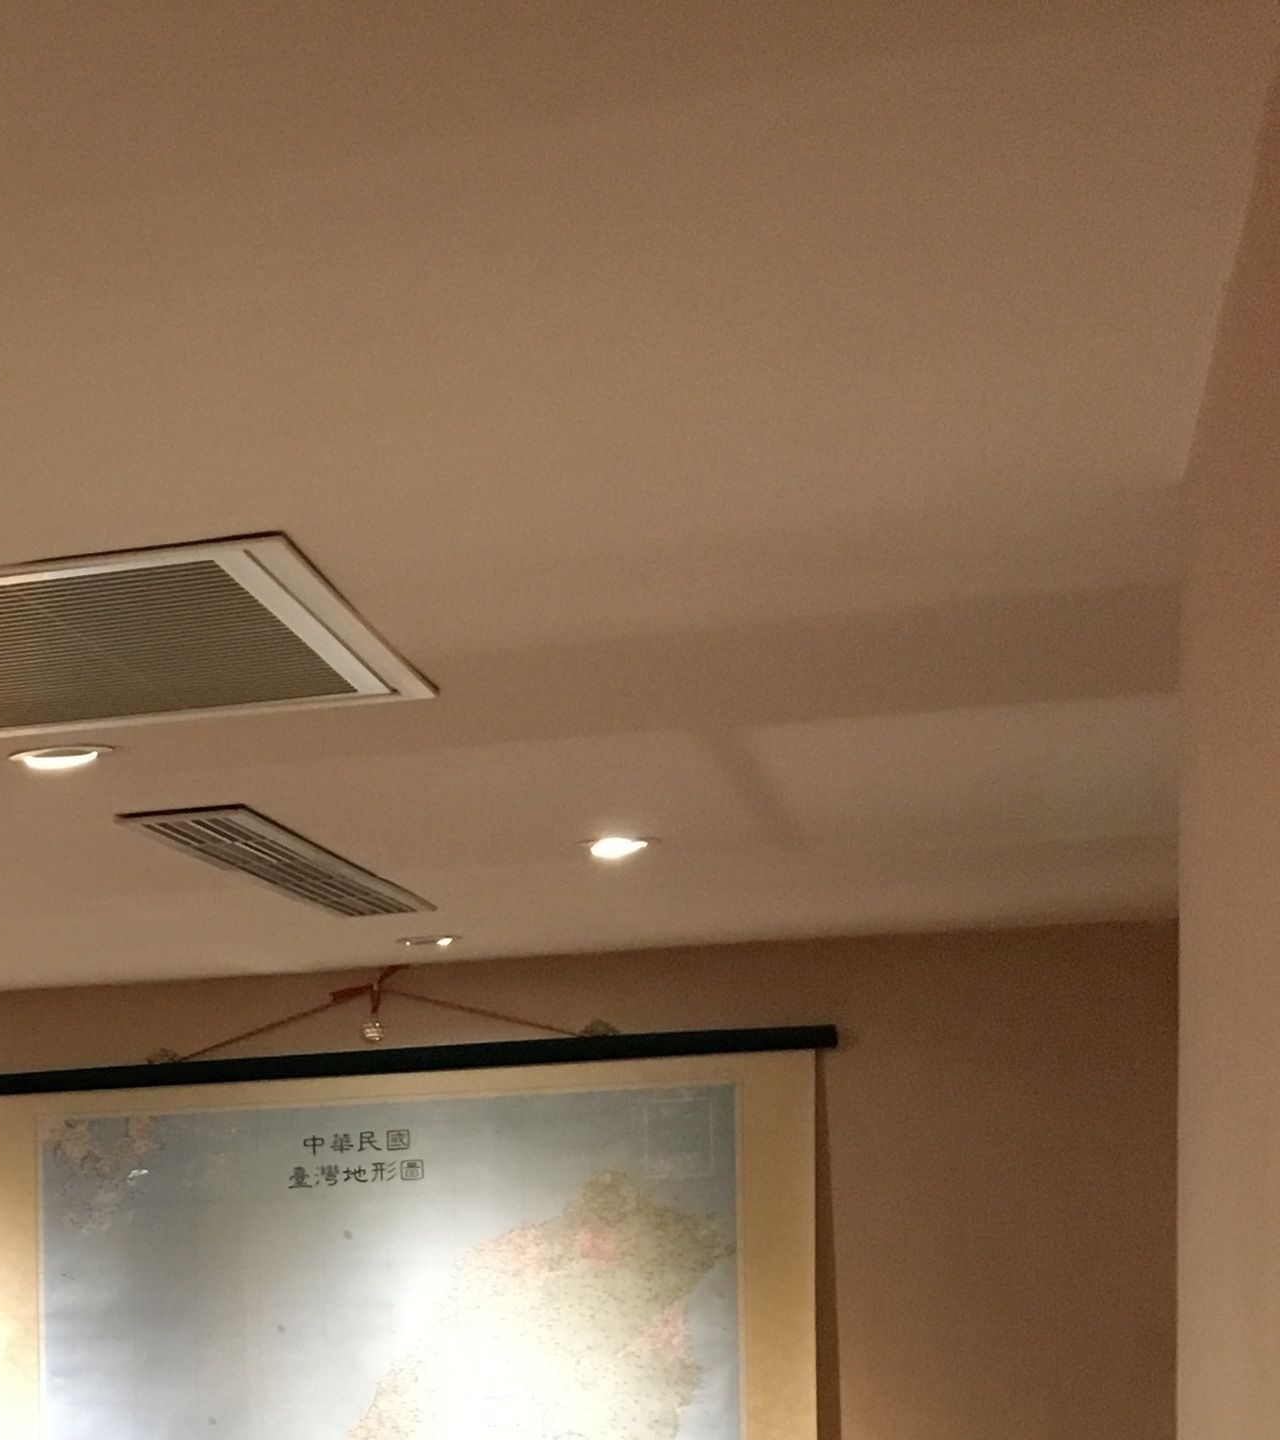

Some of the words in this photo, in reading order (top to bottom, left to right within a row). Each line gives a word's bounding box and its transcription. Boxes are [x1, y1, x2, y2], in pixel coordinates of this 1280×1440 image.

[303, 1129, 410, 1156] 中華民國
[288, 1159, 424, 1188] 臺灣地形圖
